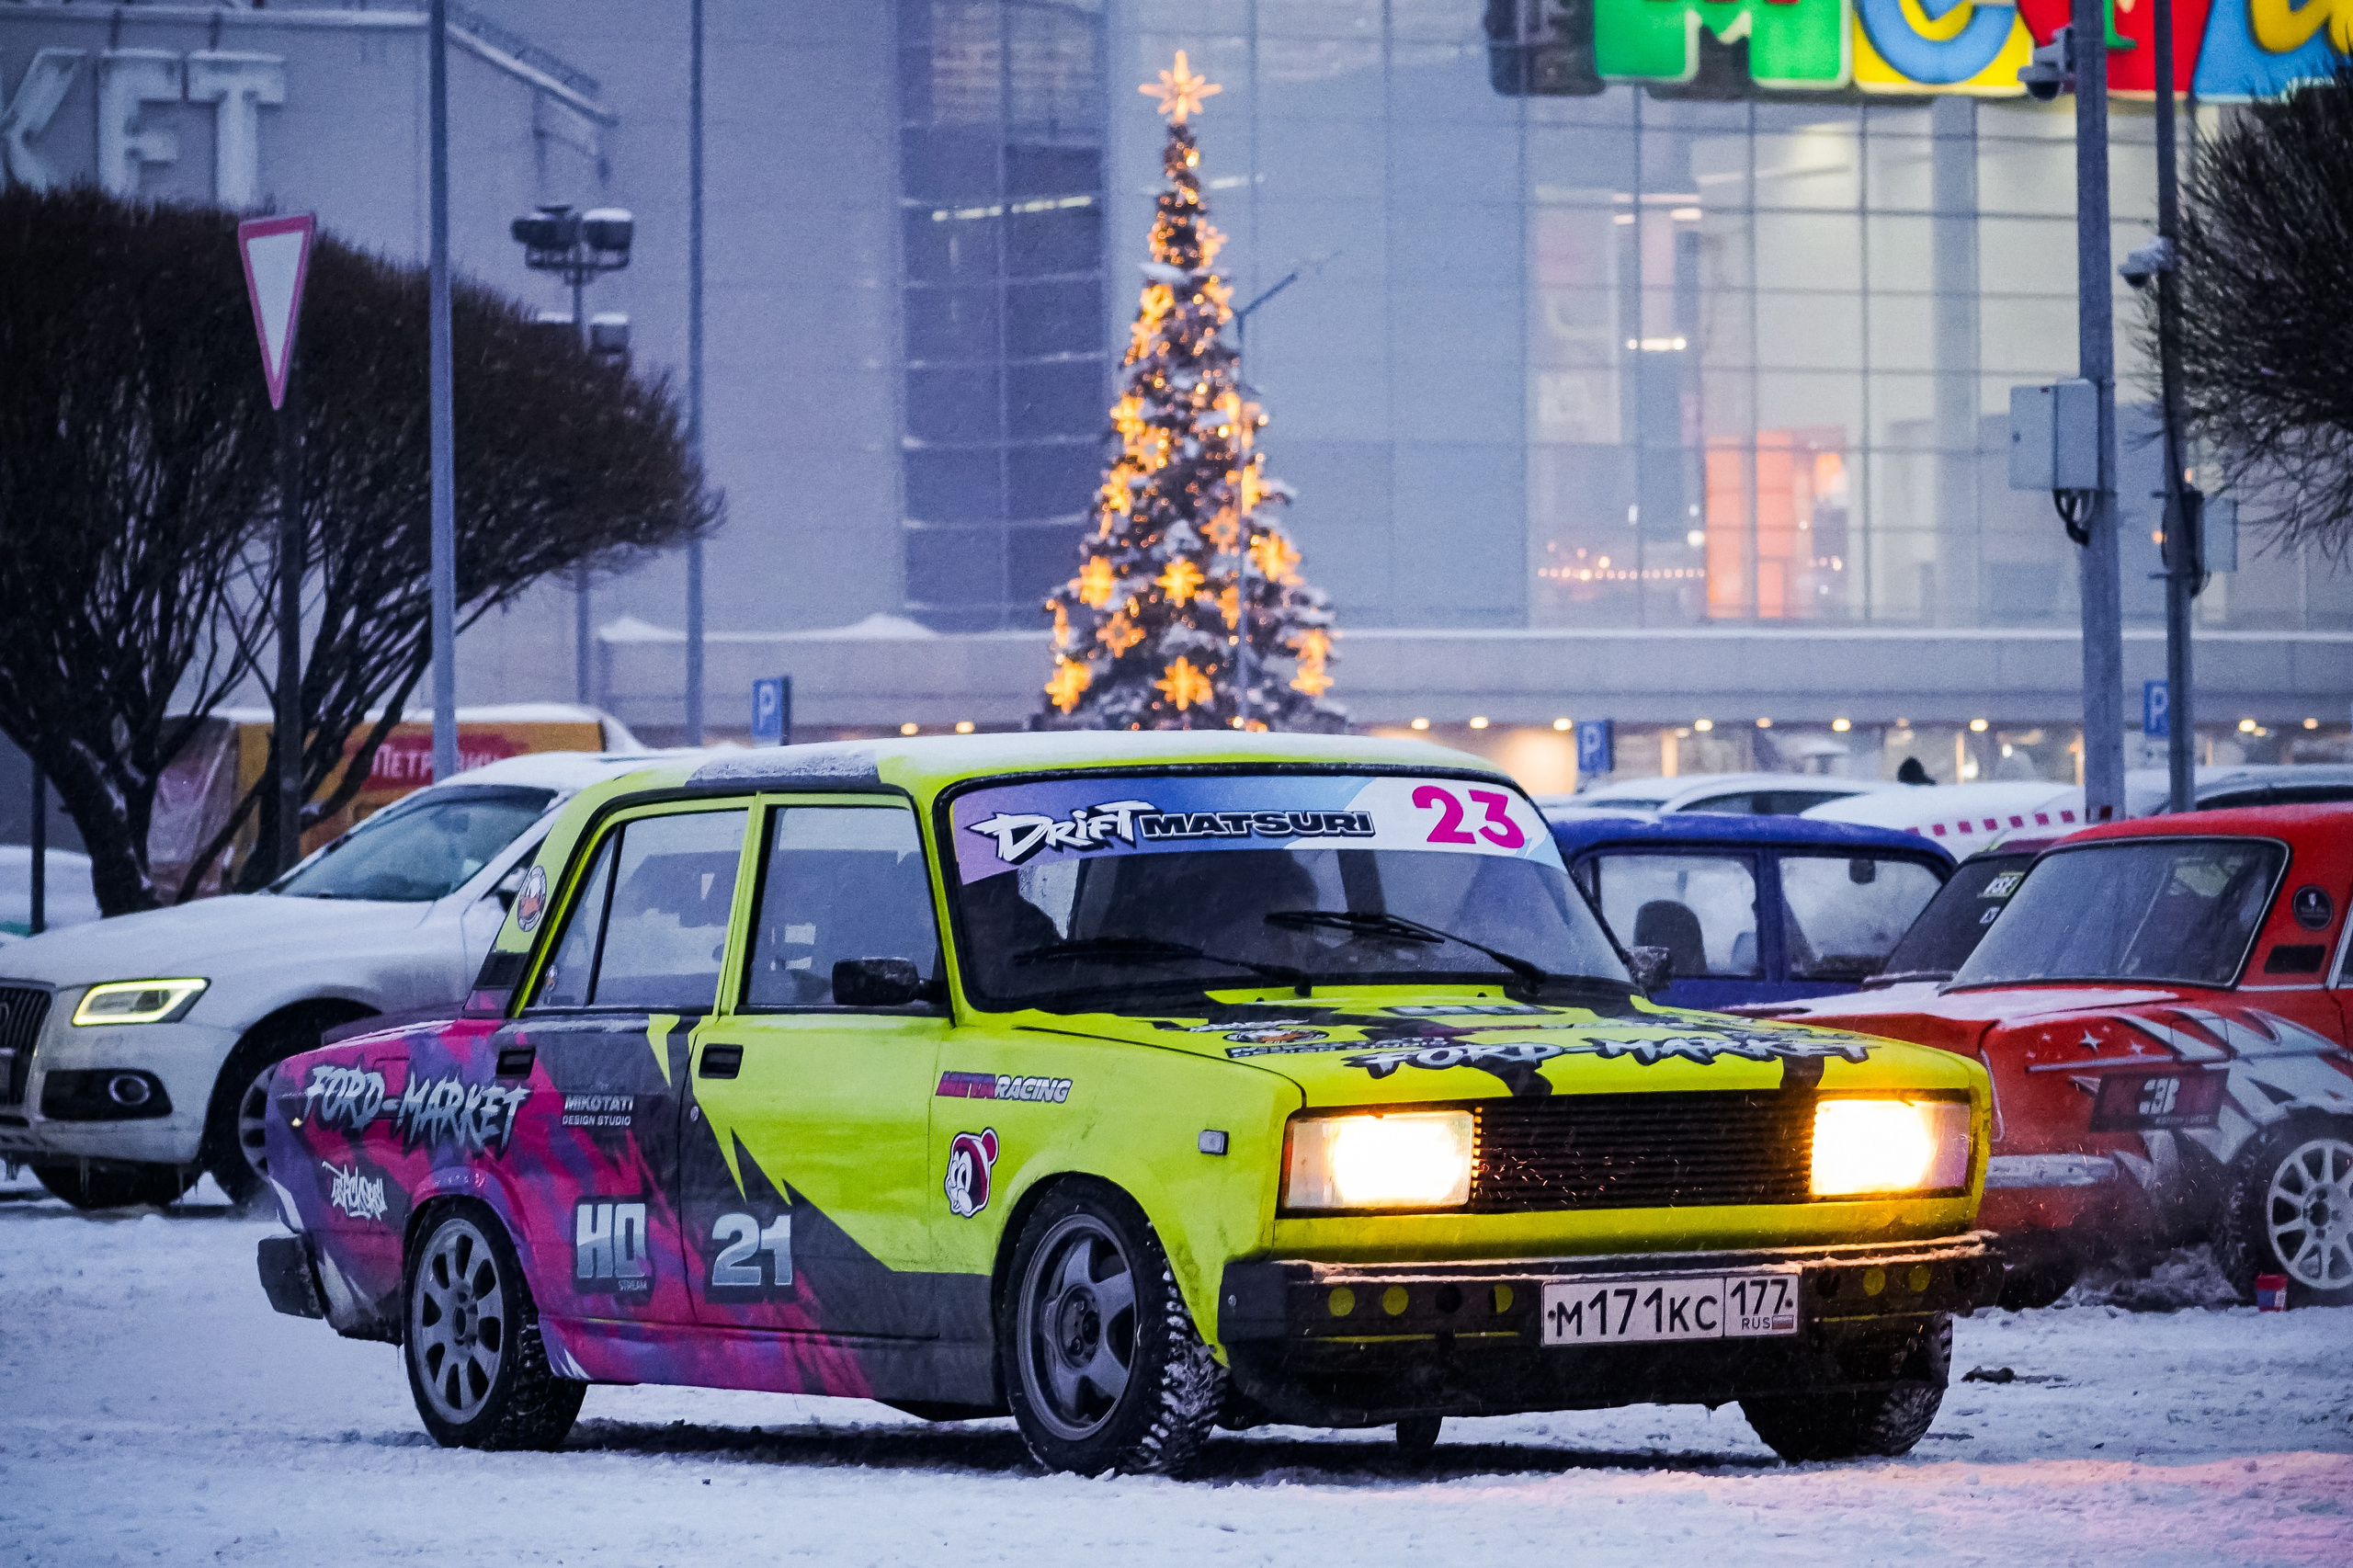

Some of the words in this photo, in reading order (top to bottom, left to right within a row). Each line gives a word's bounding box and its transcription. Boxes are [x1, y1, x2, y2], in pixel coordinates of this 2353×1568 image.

[1138, 811, 1376, 837] MATSURI
[1412, 785, 1525, 848] 23
[302, 1064, 531, 1149] FORD-MARKET
[562, 1114, 596, 1126] DESIGN
[597, 1114, 631, 1126] STUDIO
[711, 1211, 793, 1287] 21
[1730, 1278, 1789, 1316] 177
[1741, 1317, 1770, 1330] RUS
